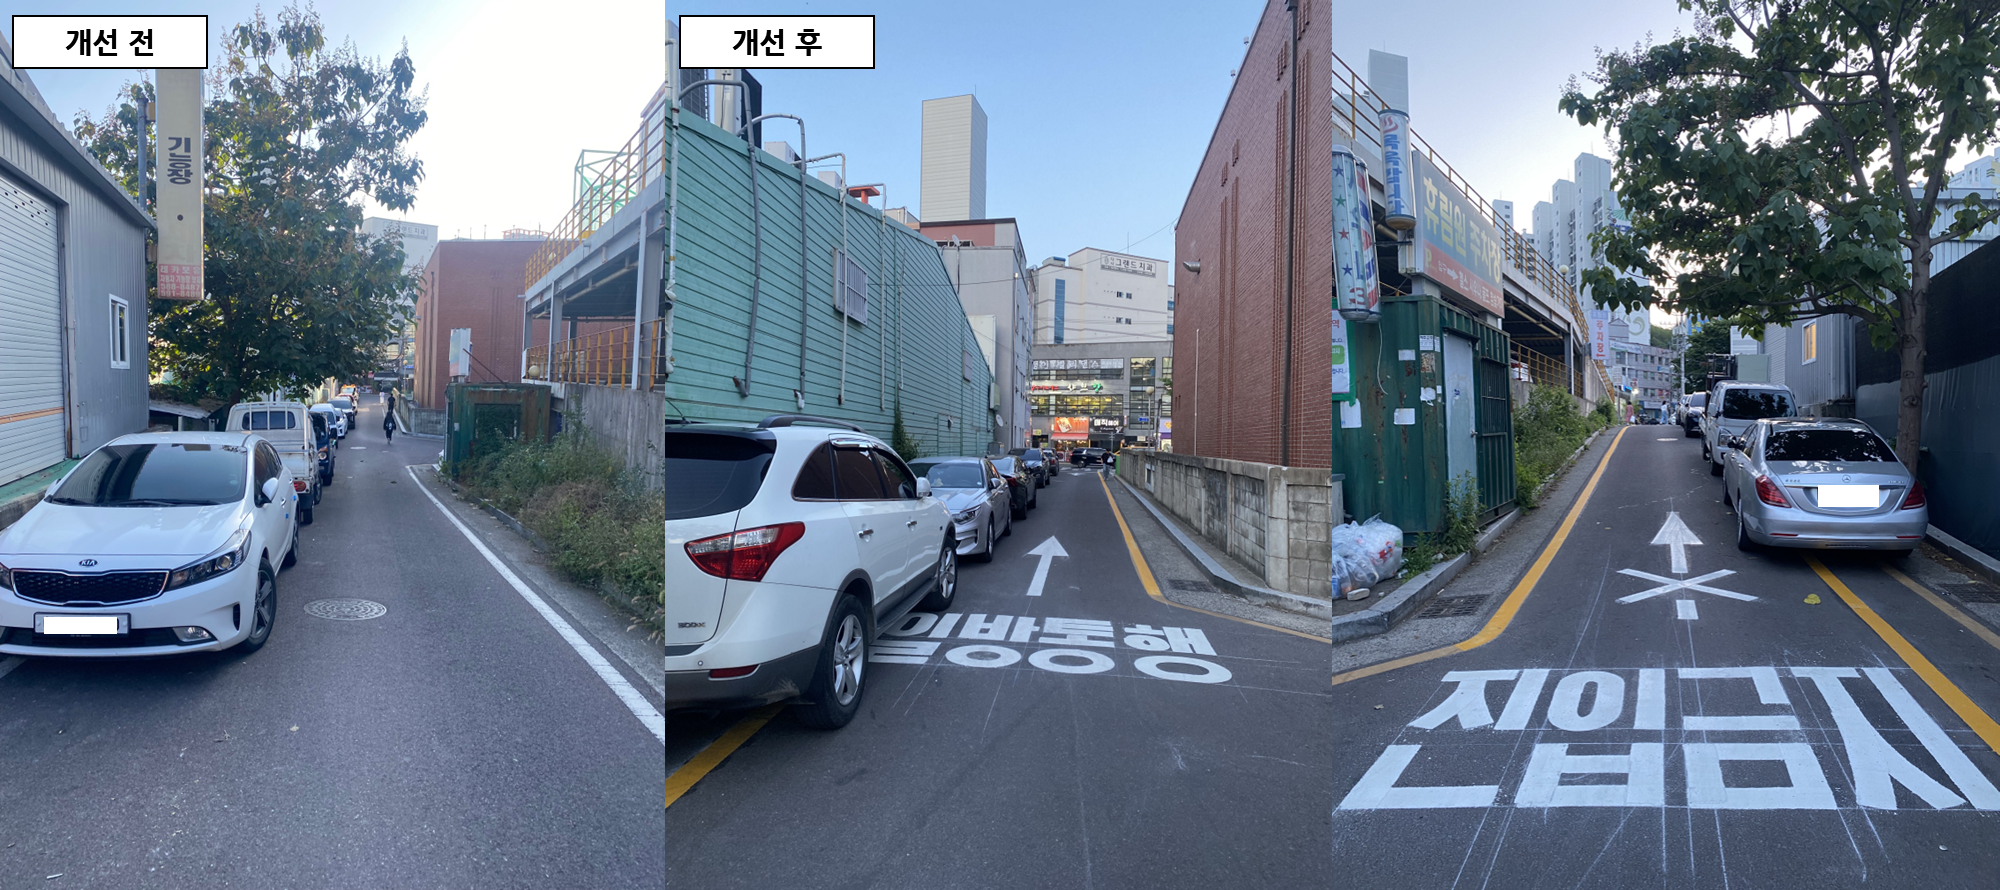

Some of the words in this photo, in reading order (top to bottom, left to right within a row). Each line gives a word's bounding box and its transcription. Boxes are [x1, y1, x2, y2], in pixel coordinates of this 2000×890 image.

[167, 137, 193, 185] 기능장
[1424, 177, 1466, 257] 휴림원
[1470, 220, 1501, 283] 주차장
[1115, 258, 1137, 269] 그랜드
[1139, 262, 1153, 272] 치과
[1596, 320, 1604, 353] 주차장
[80, 559, 97, 567] KIA
[869, 613, 1233, 684] 일방통행
[1338, 666, 2000, 811] 진입금지
